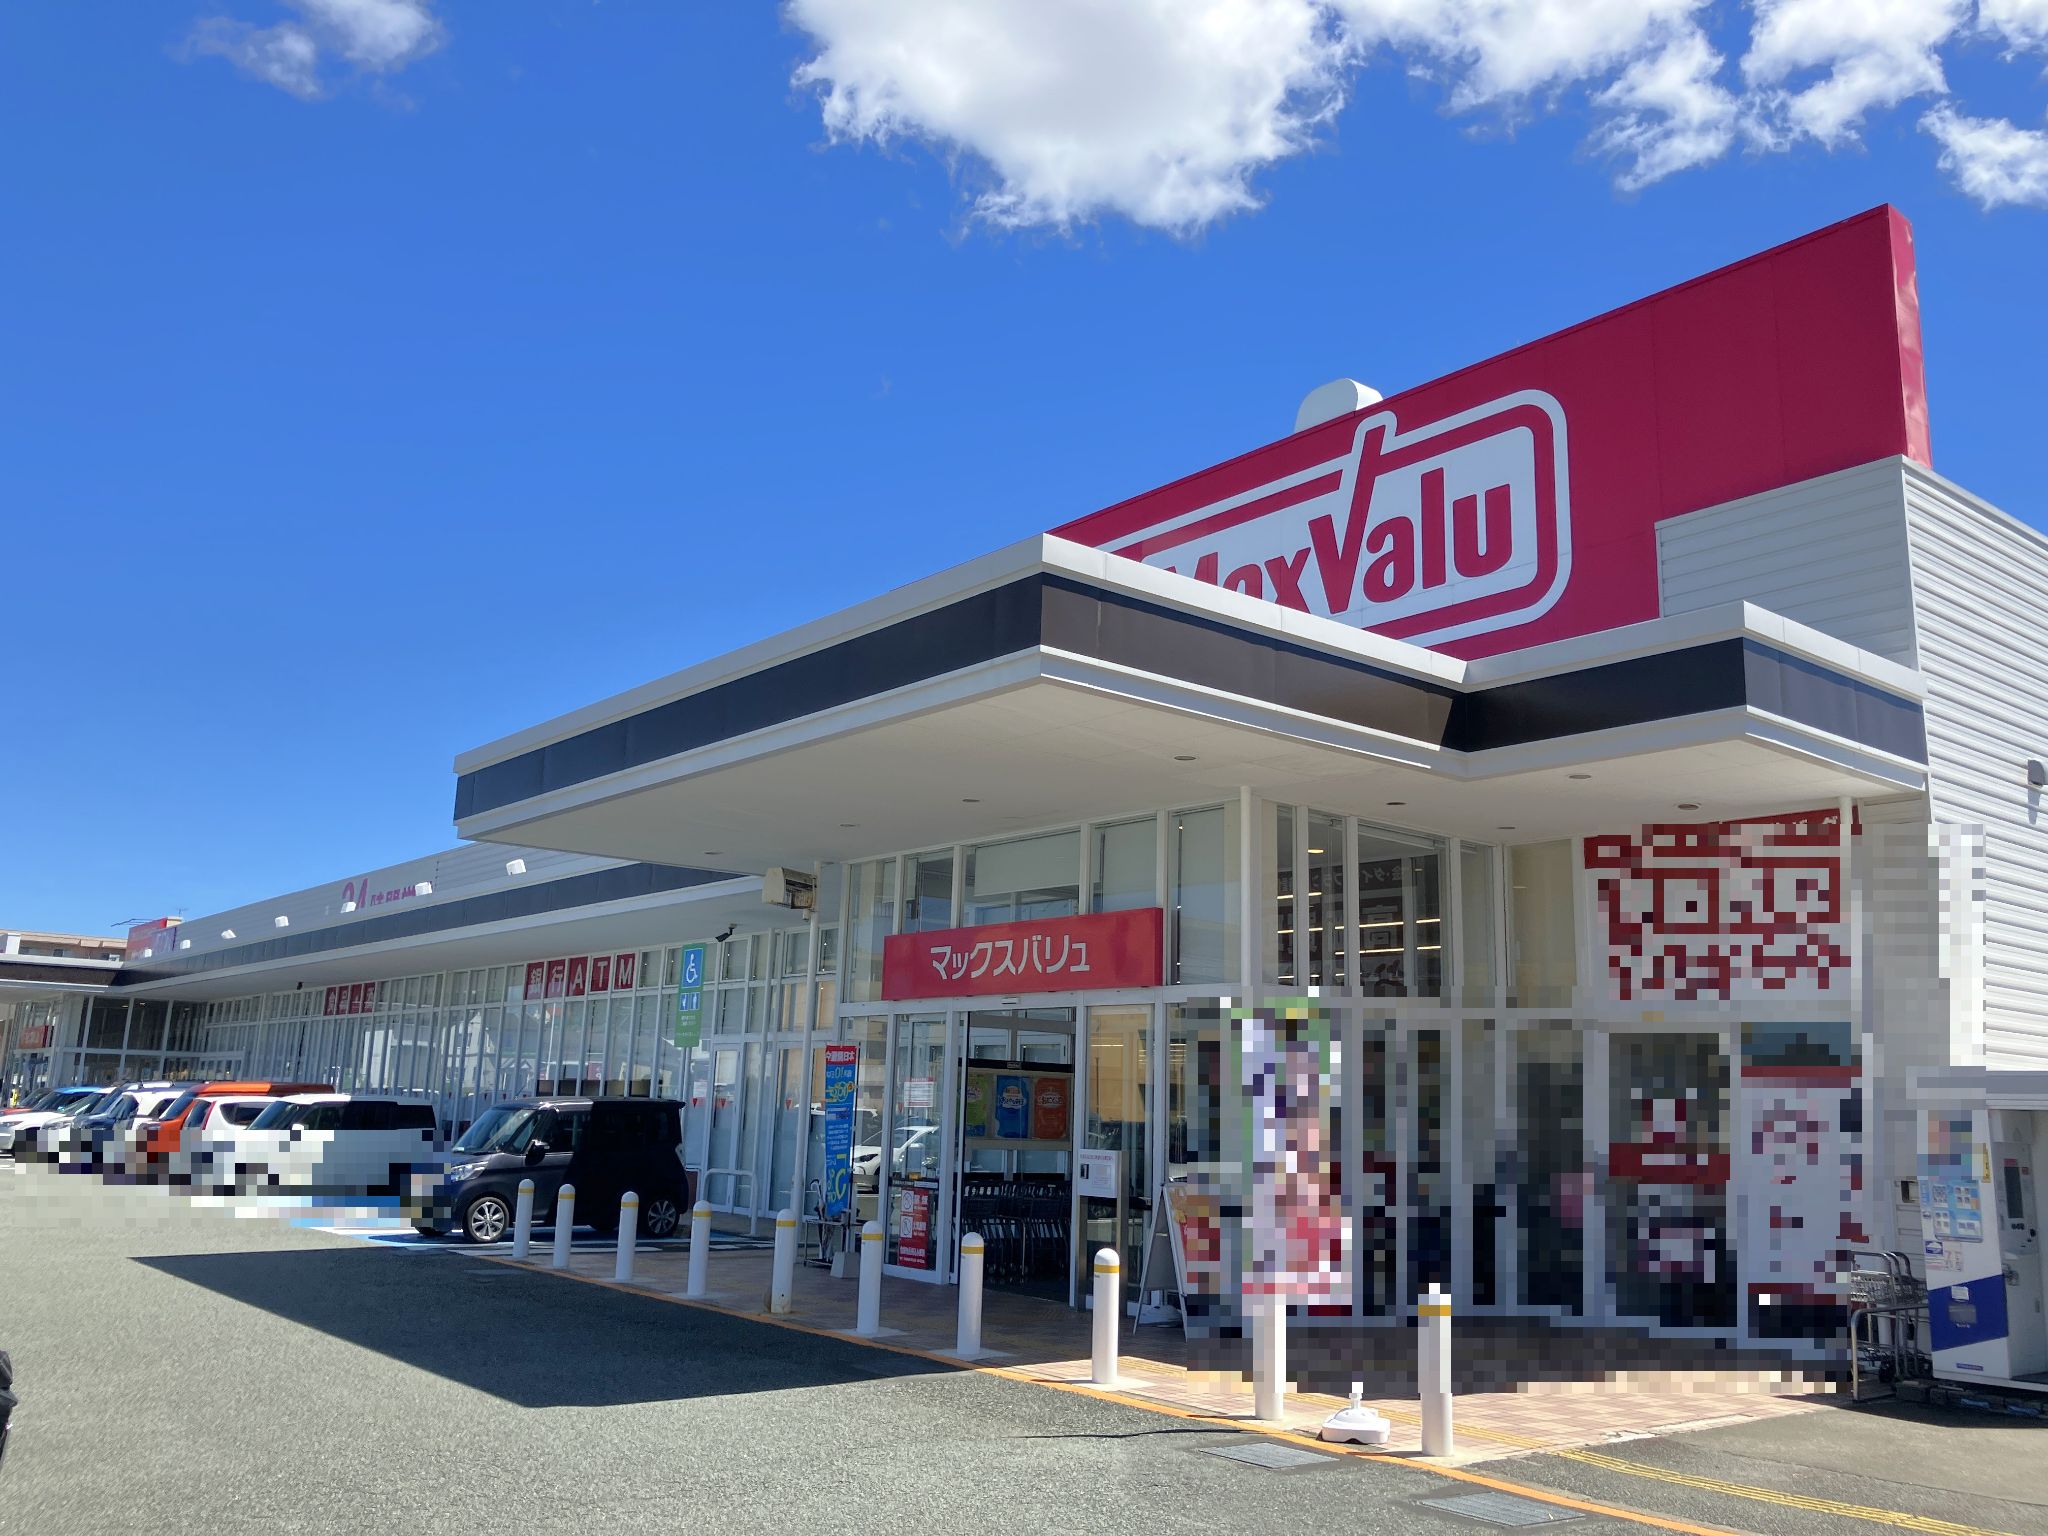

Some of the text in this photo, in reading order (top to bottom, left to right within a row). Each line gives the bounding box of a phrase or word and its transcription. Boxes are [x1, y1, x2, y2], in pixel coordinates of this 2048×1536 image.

[1163, 424, 1513, 615] xValu
[530, 958, 633, 995] 銀行ATM
[930, 934, 1091, 981] マックスバリュ
